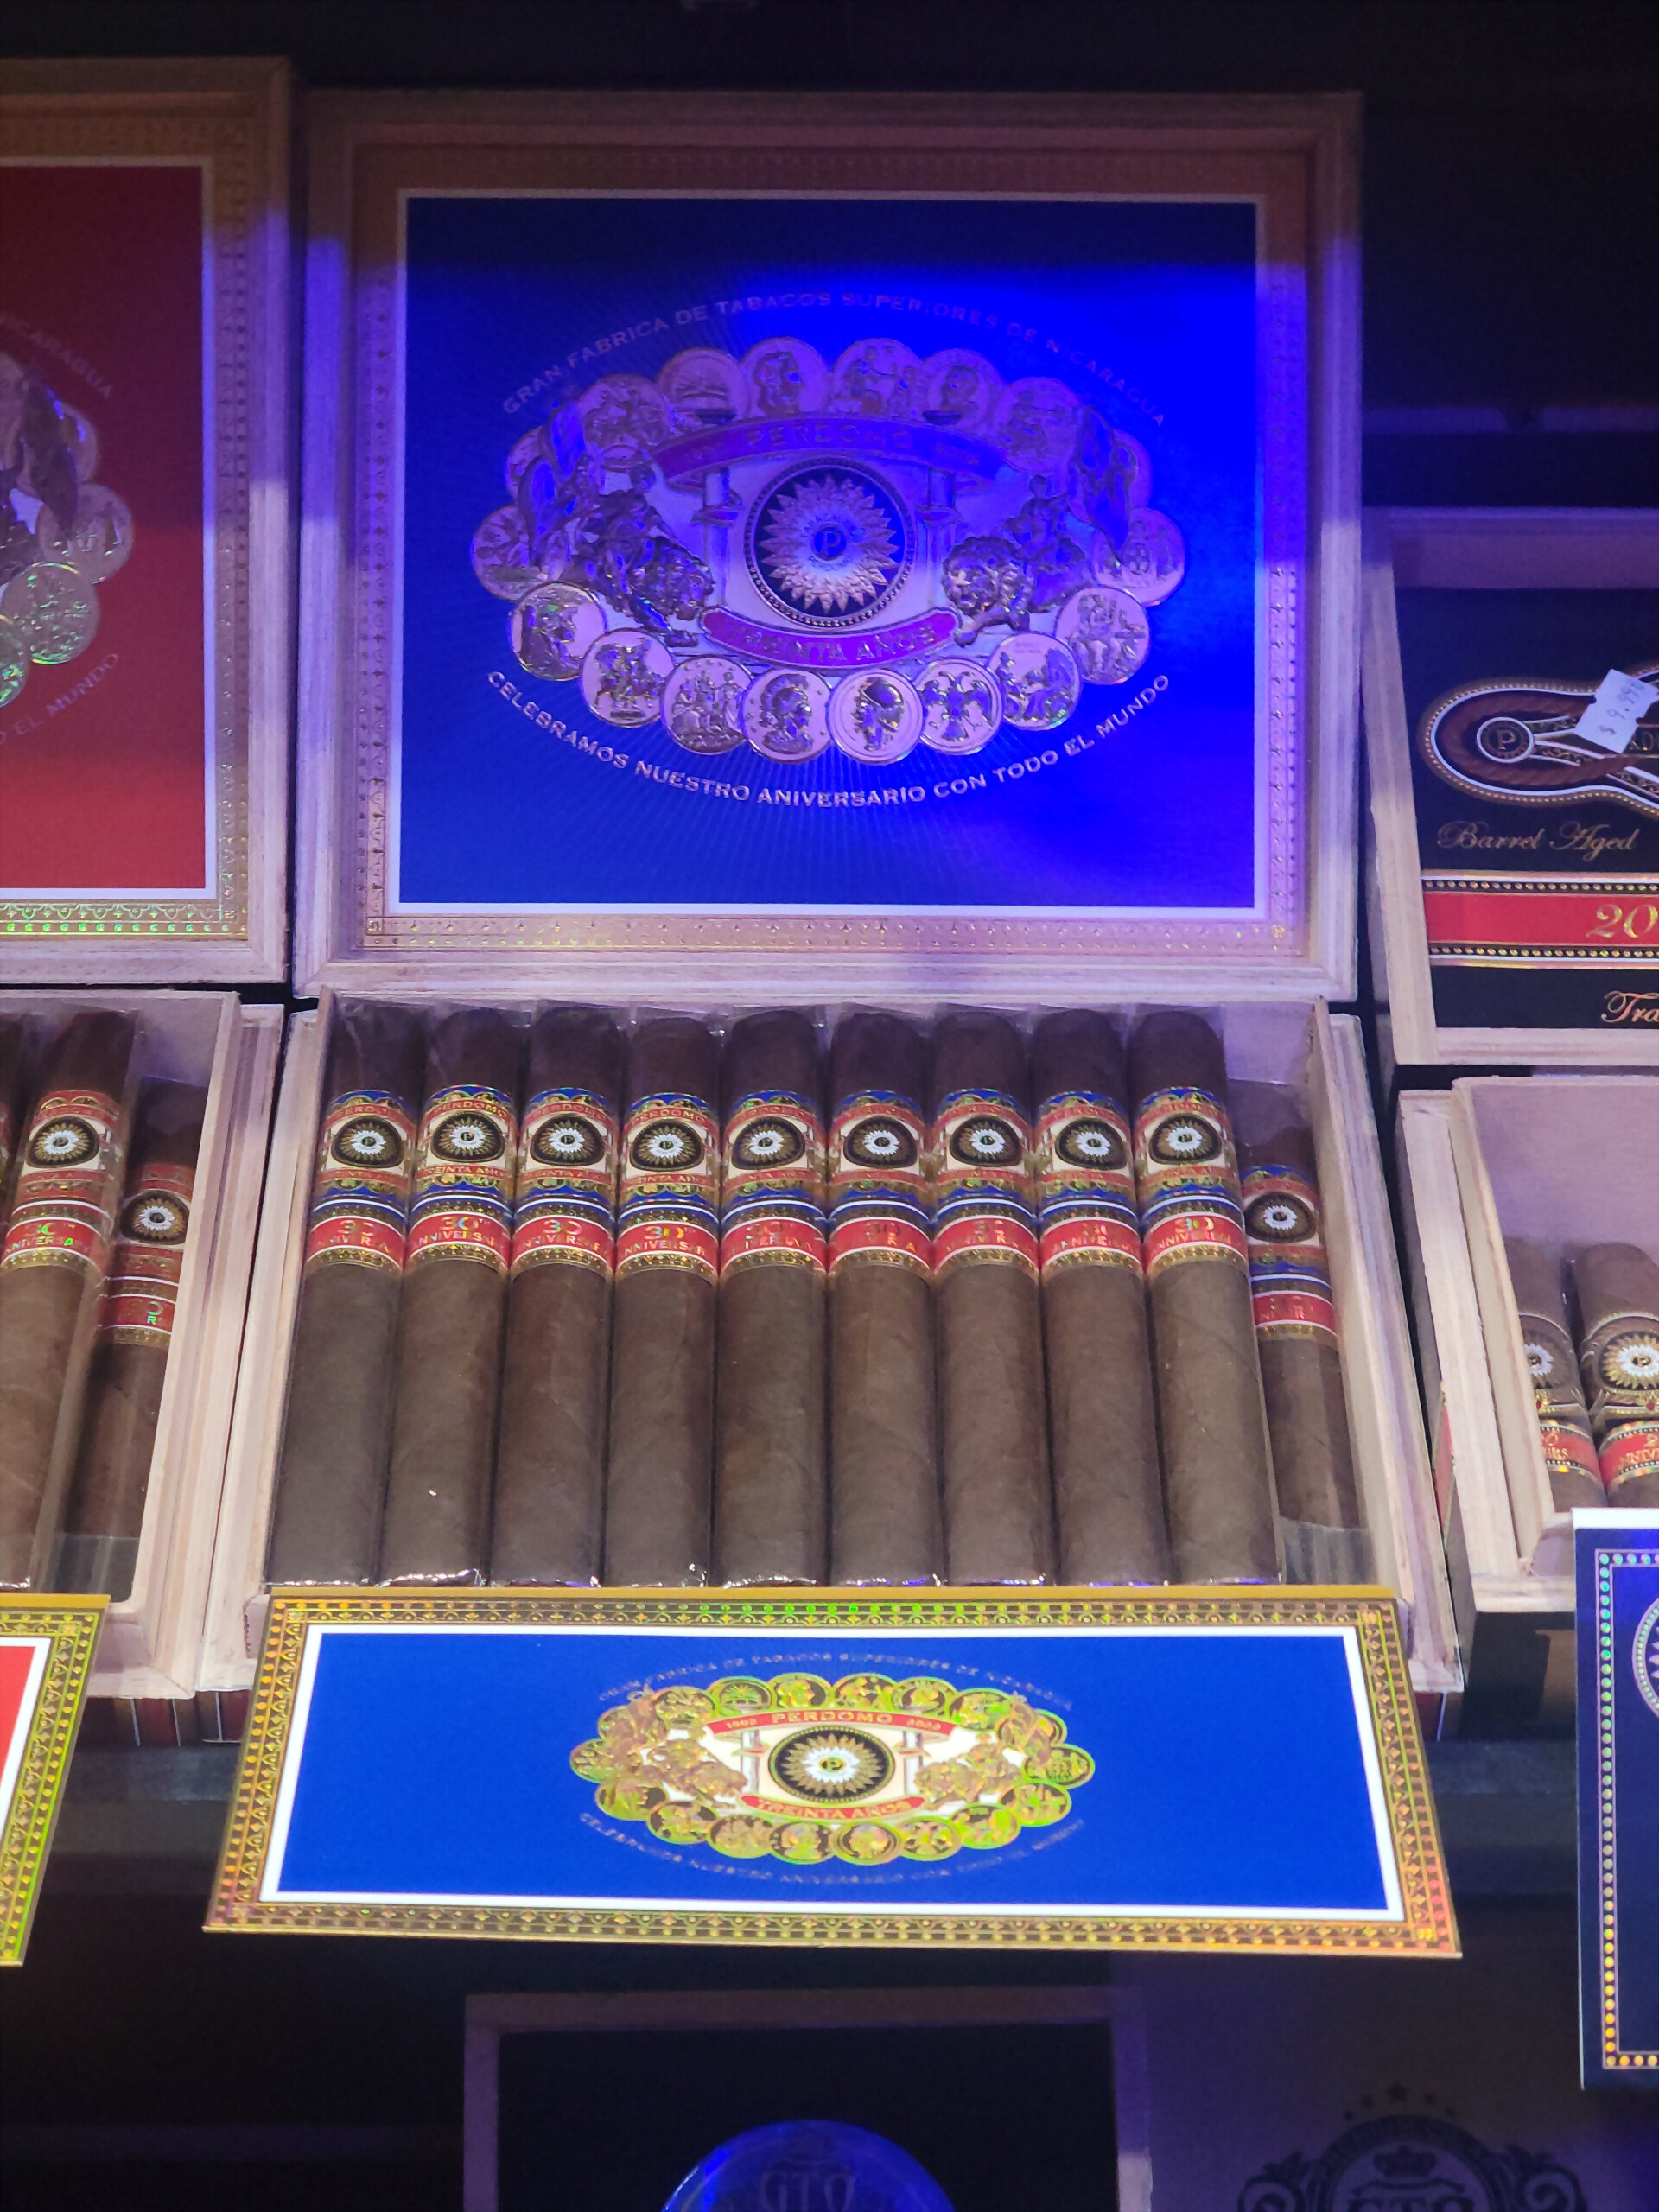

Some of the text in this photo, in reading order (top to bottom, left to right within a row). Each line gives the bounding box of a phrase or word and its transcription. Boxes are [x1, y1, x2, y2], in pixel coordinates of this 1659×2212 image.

[503, 291, 1165, 428] GRAN FABRICA DE TABACOS SUPERIORES DE NICARAGUA
[45, 653, 119, 720] MUNDO
[487, 671, 1169, 808] CELEBRAMOS NUESTRO ANIVERSARIO CON TODO EL MUNDO
[1436, 820, 1641, 862] Barrel Aged
[772, 1711, 893, 1724] PERDOMO
